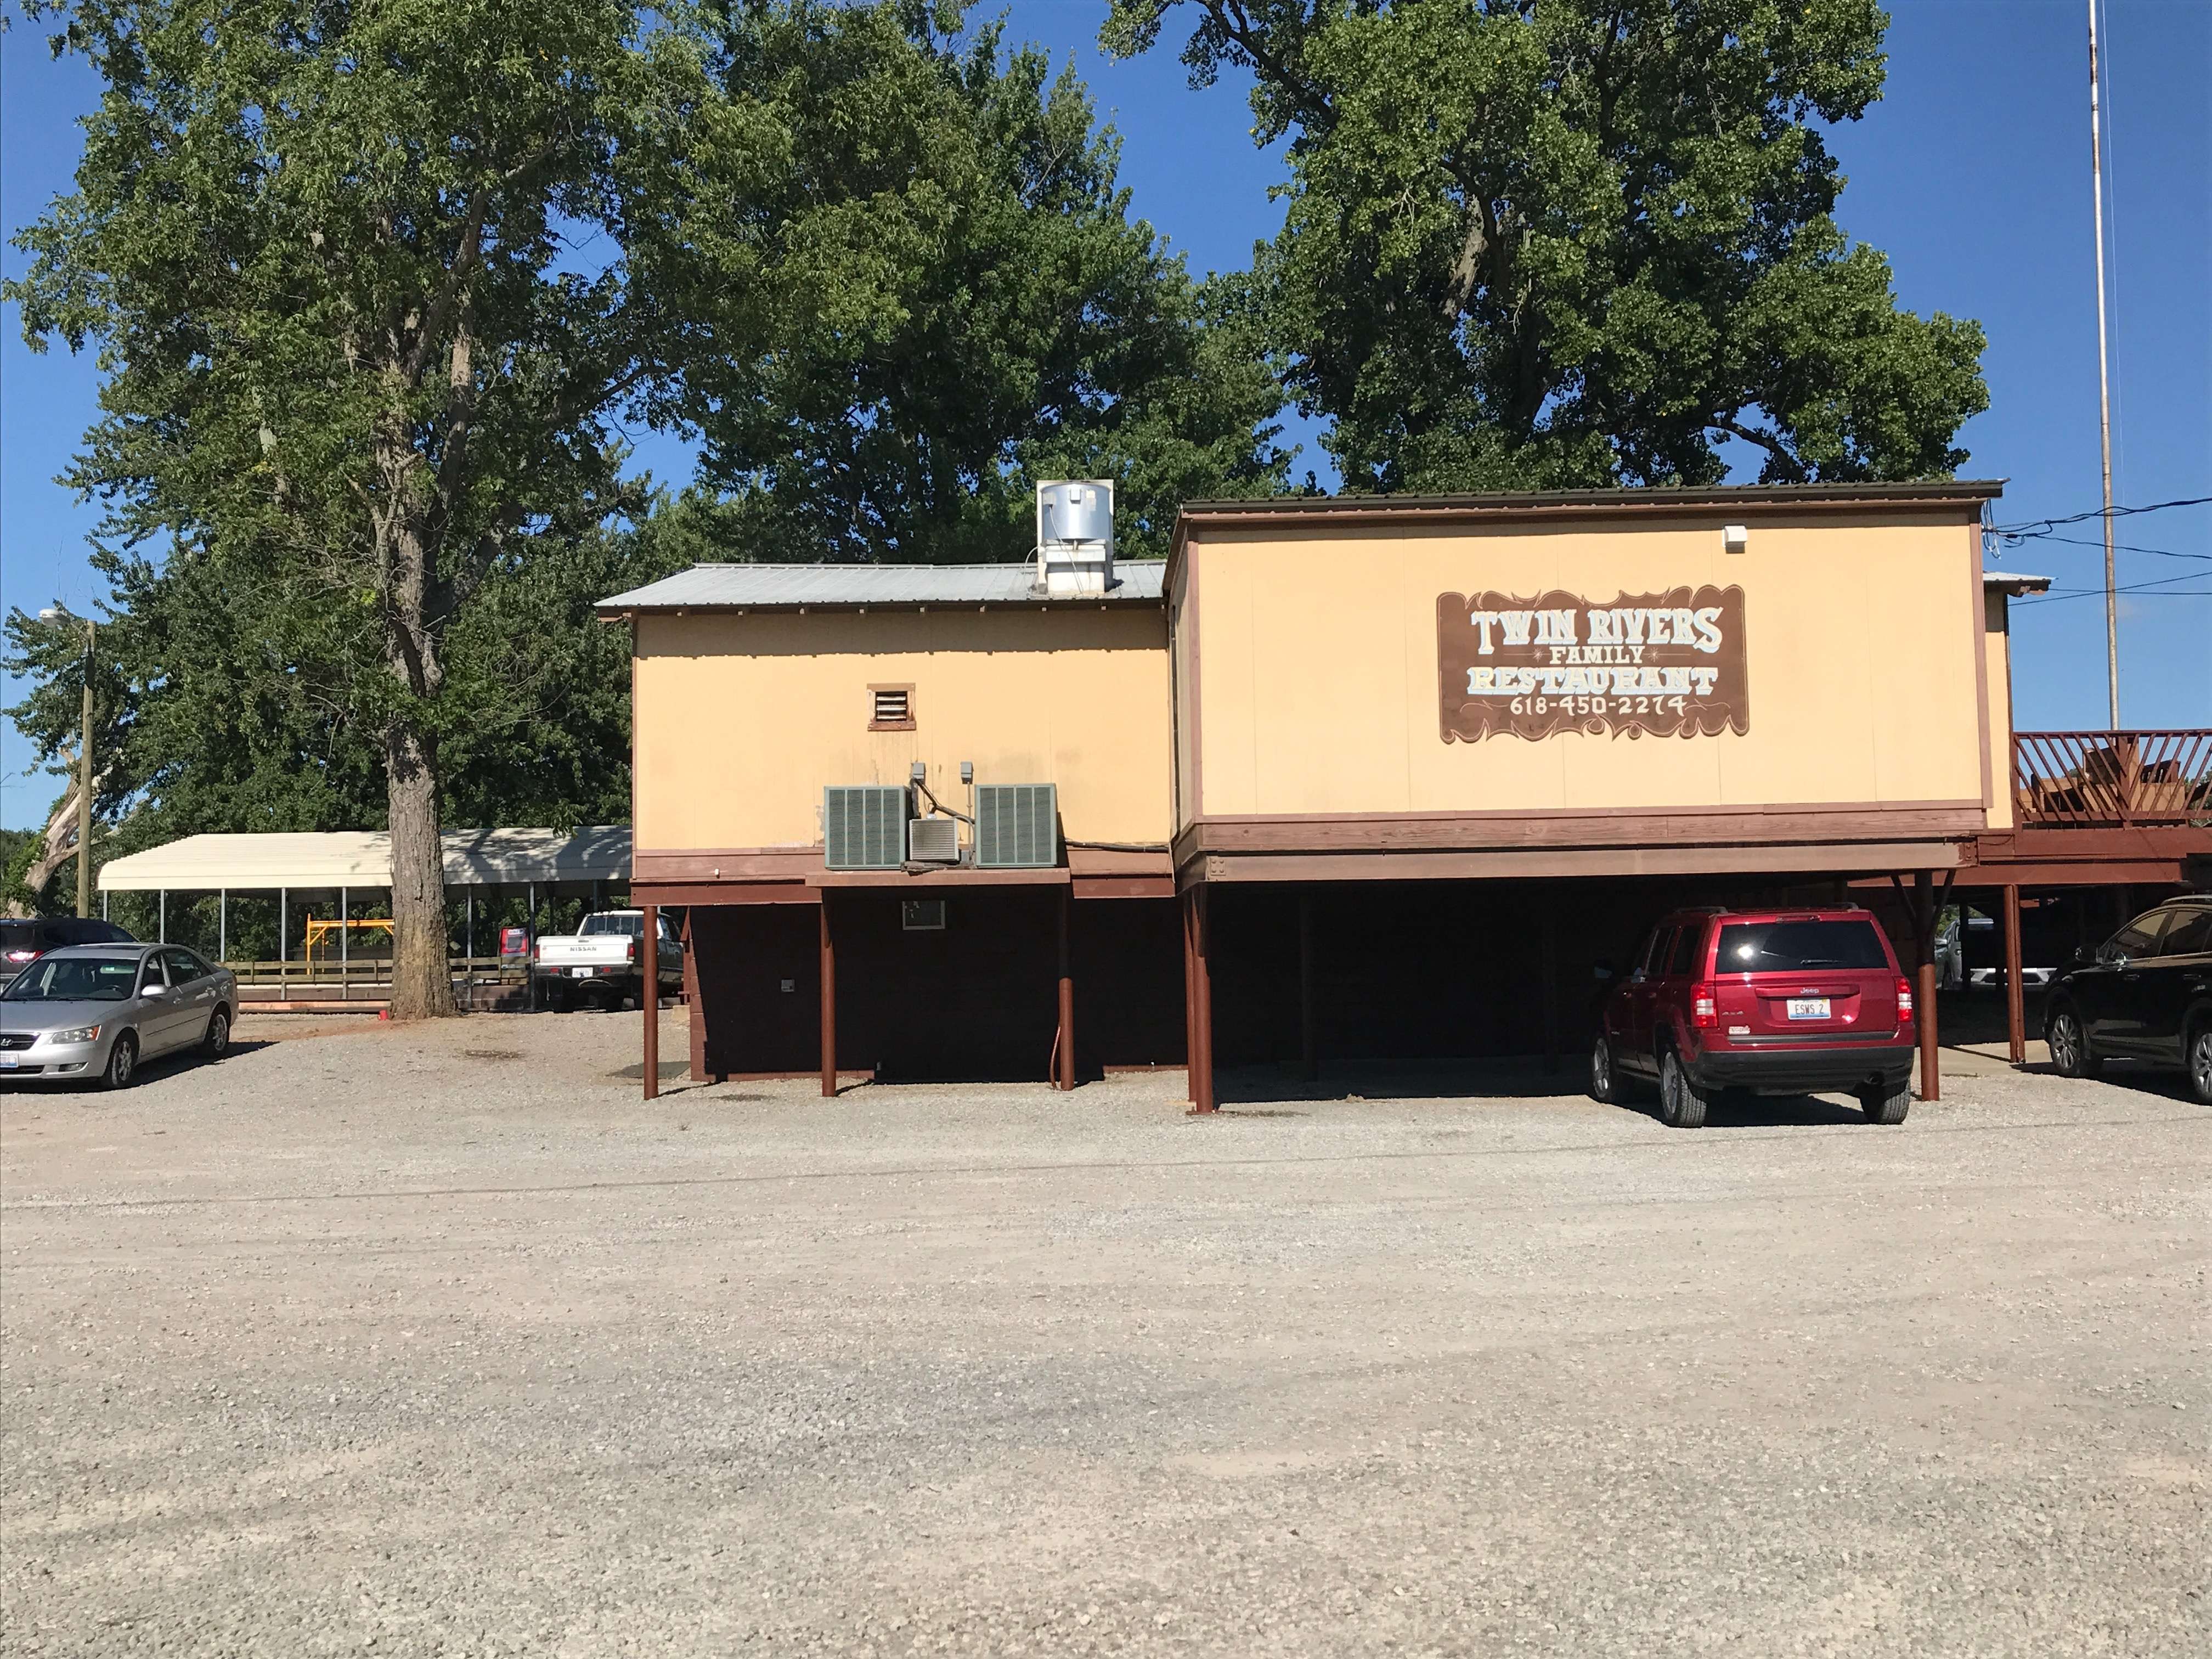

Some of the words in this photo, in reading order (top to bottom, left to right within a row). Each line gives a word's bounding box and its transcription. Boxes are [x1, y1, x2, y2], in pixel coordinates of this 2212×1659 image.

[1471, 609, 1578, 654] TWIN
[1587, 606, 1723, 653] RIVERS
[1549, 646, 1645, 664] FAMILY
[1466, 666, 1718, 695] RESTAURANT
[1510, 695, 1688, 716] 618-450-2274
[1795, 1003, 1815, 1015] ESWS
[1819, 1003, 1824, 1014] 2
